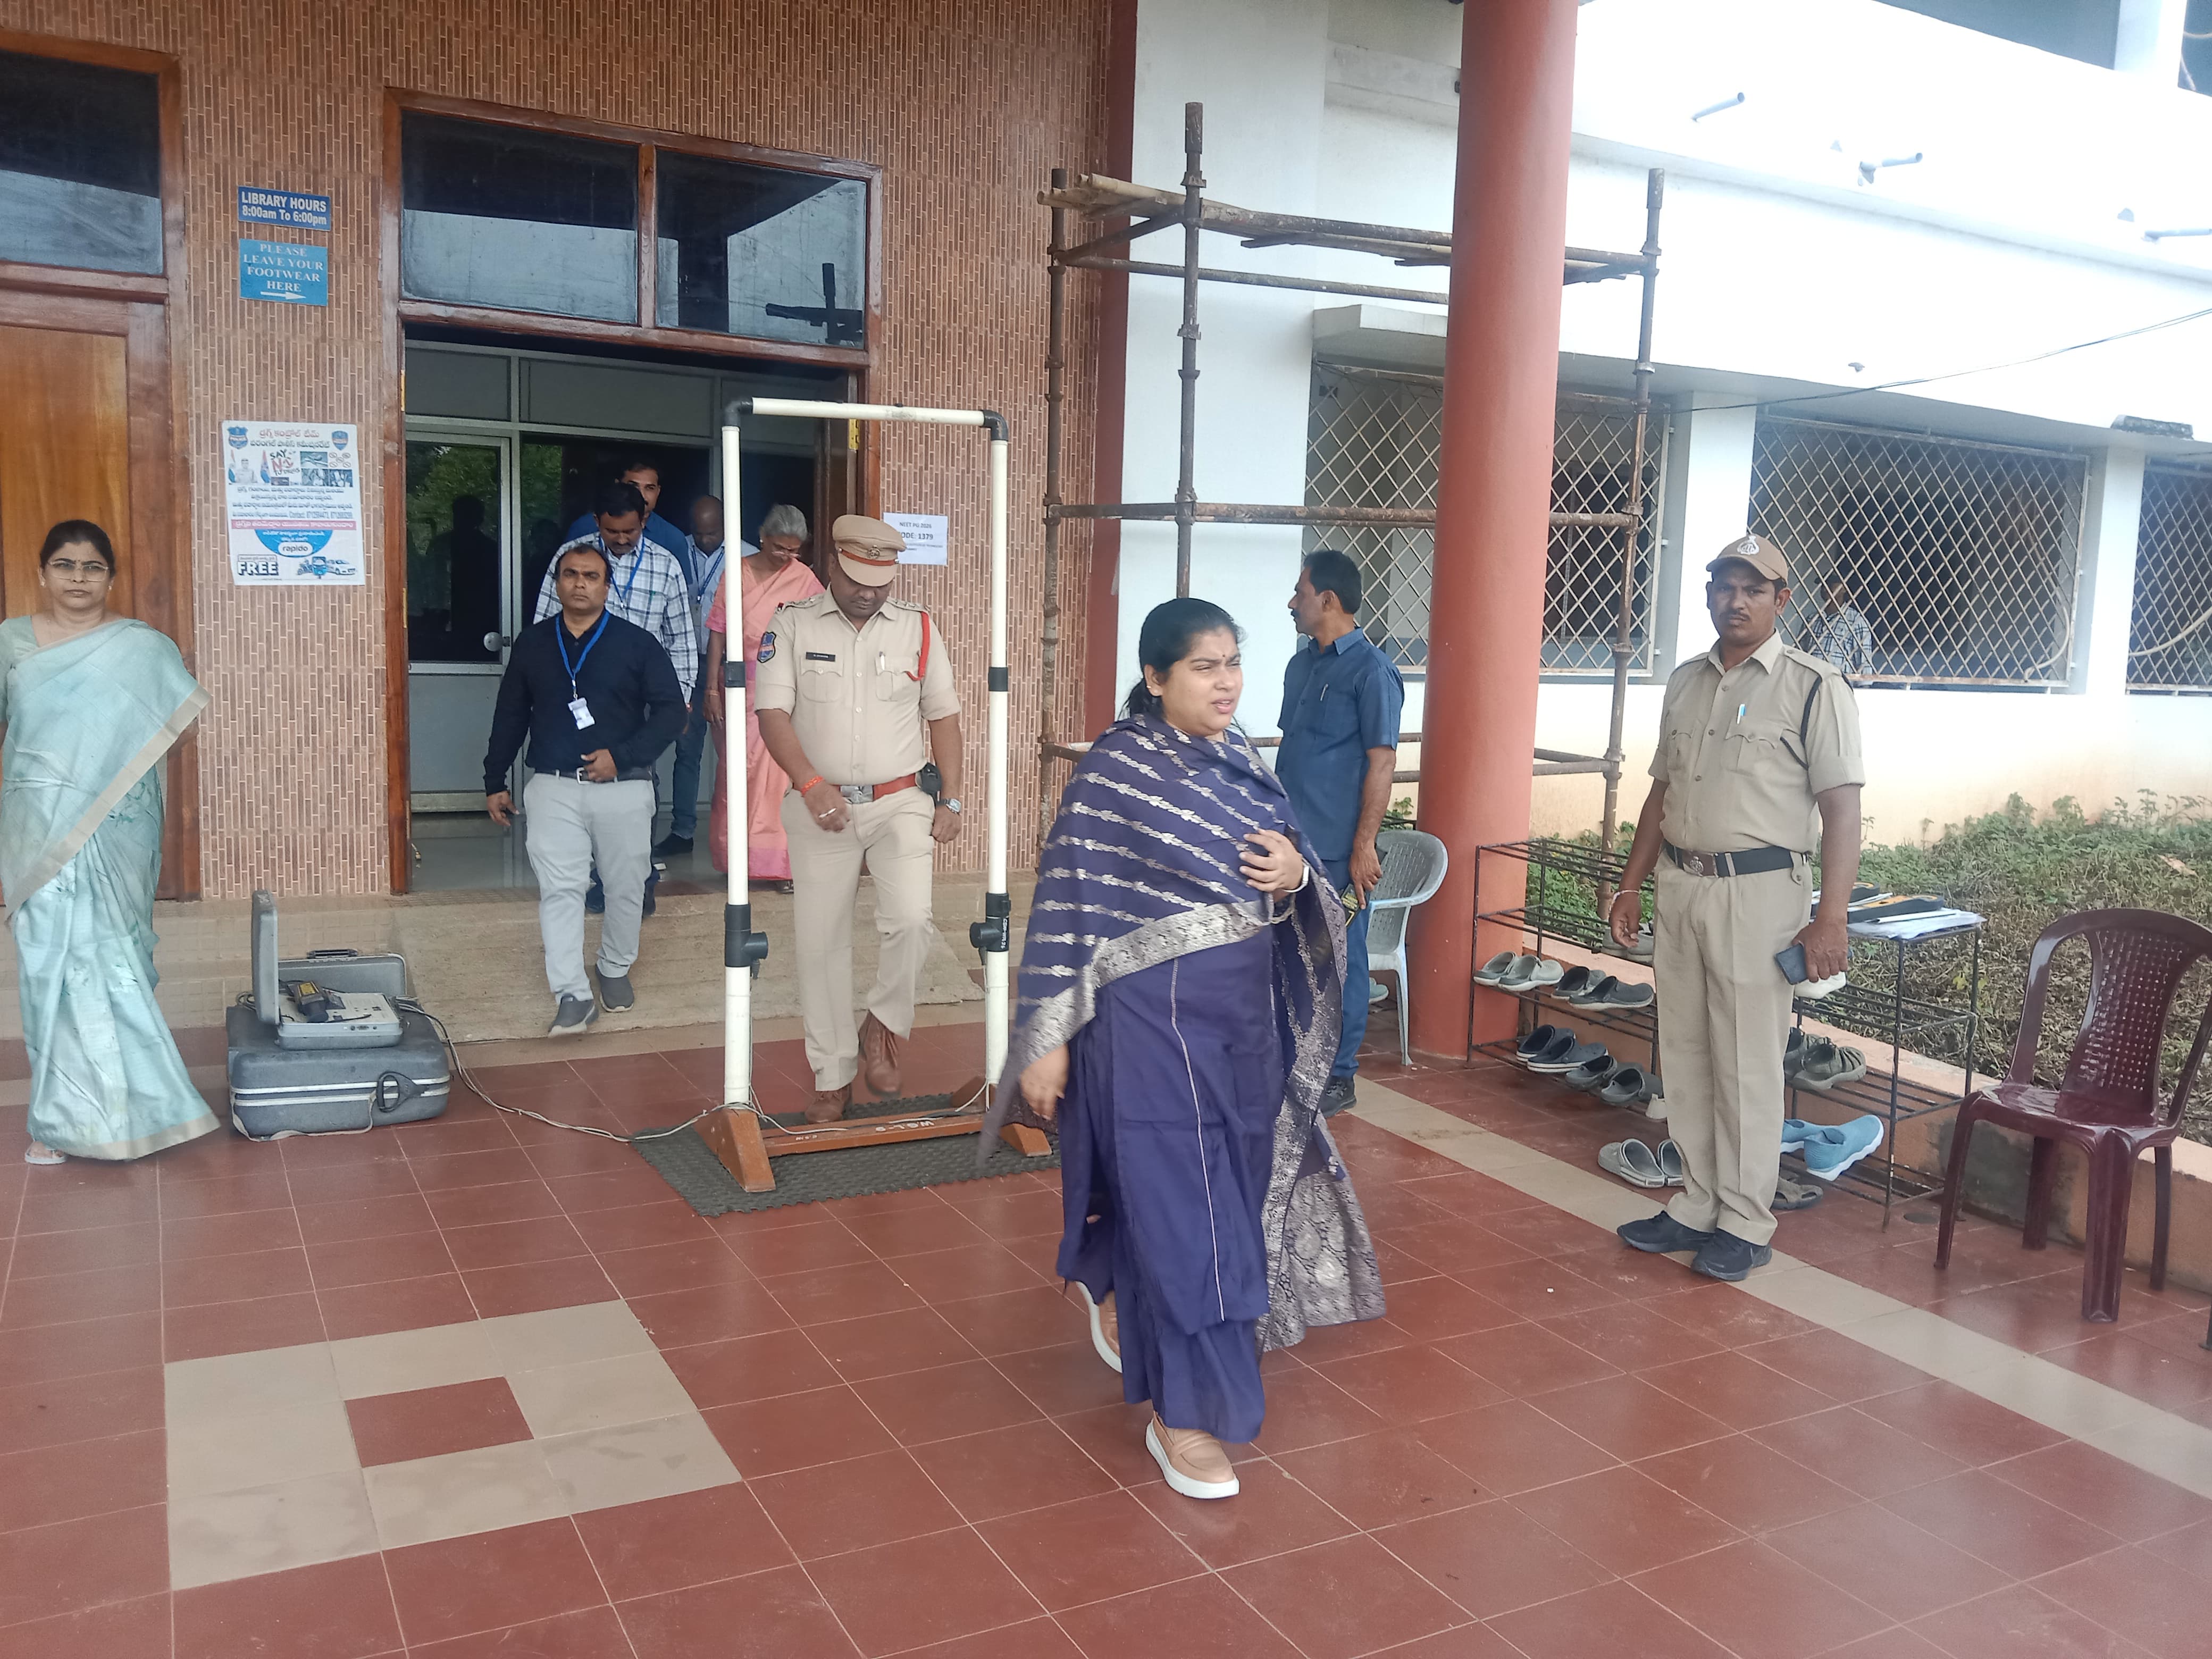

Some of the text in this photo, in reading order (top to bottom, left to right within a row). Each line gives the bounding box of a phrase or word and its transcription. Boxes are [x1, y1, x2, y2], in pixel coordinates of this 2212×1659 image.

[242, 191, 326, 212] LIBRARY HOURS
[242, 205, 327, 226] 8:00am To 6:00pm
[260, 244, 307, 257] PLEASE
[244, 254, 323, 271] LEAVE YOUR
[248, 266, 320, 282] FOOTWEAR
[267, 281, 301, 292] HERE
[270, 449, 287, 460] SAY
[282, 544, 308, 553] rapido
[238, 561, 279, 575] FREE
